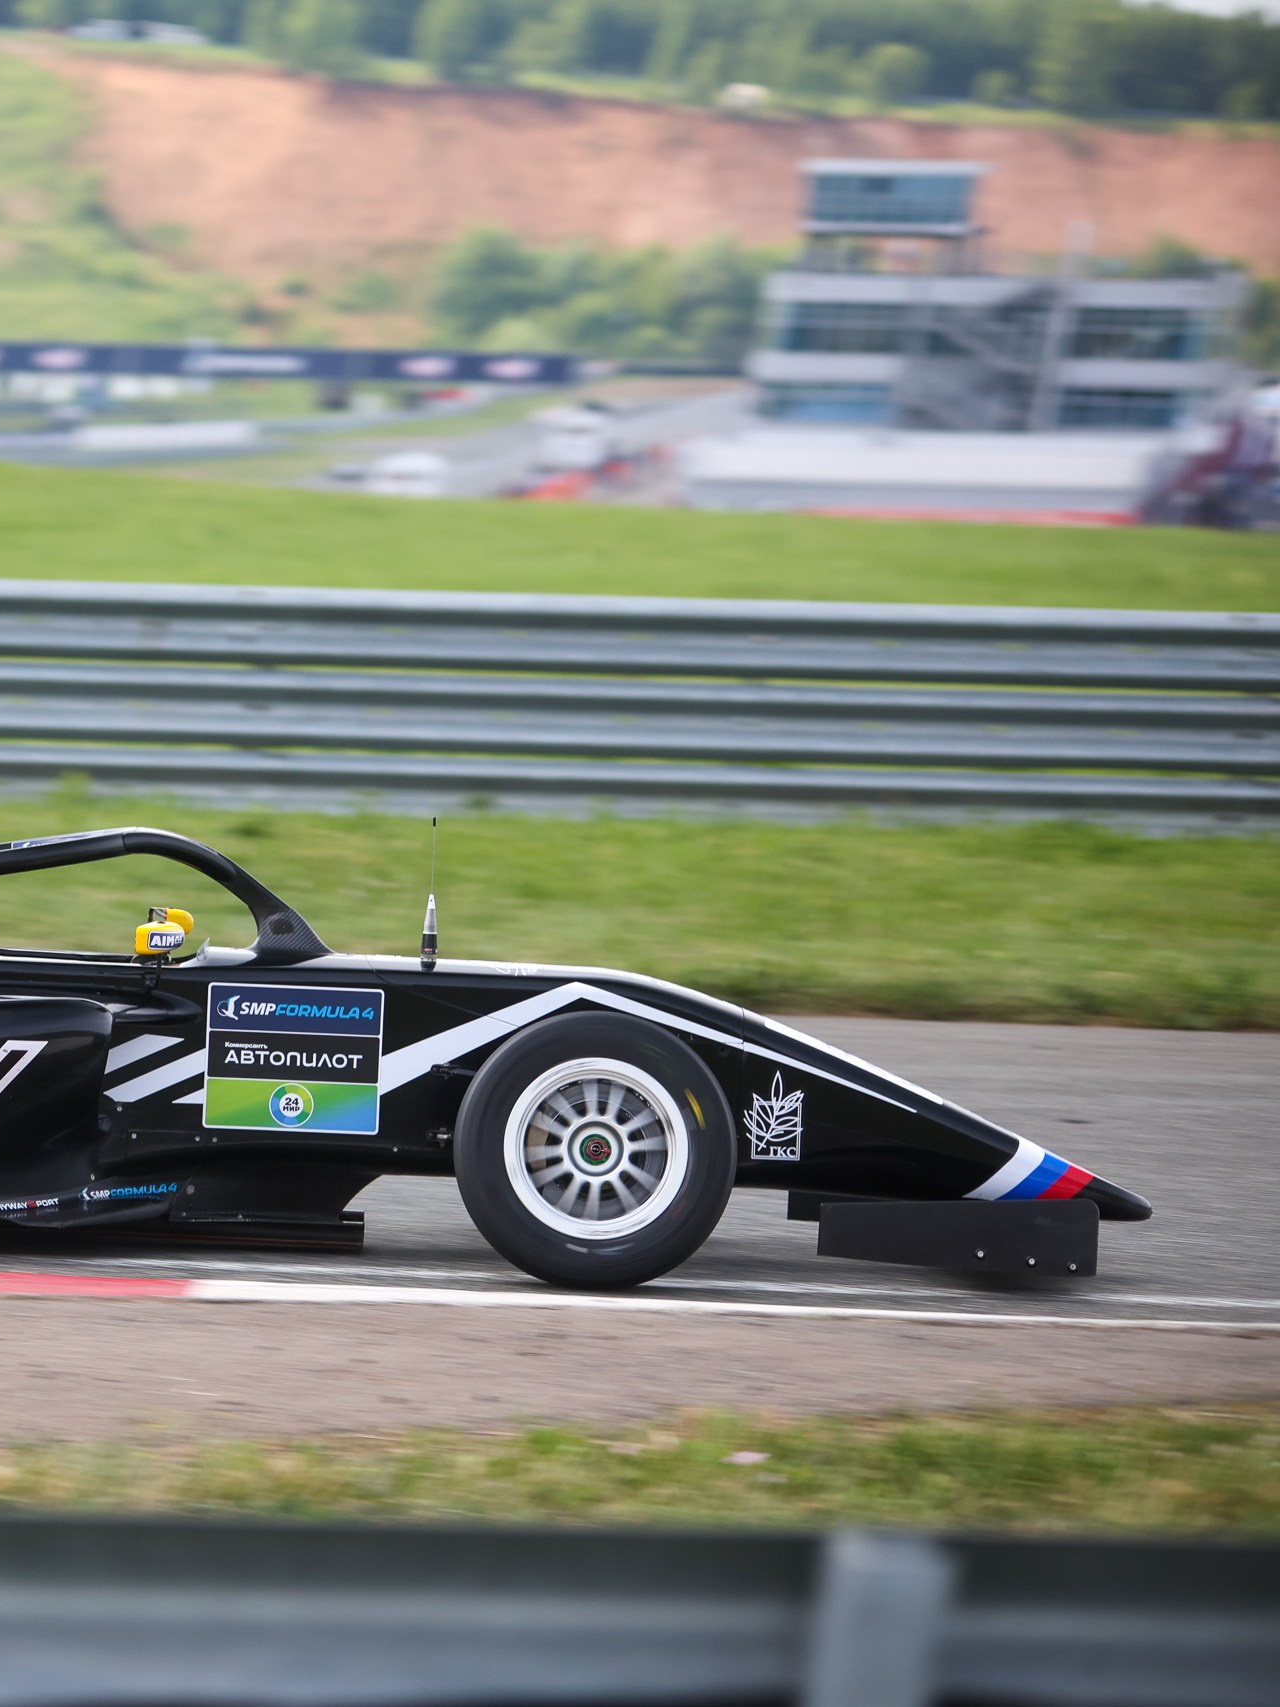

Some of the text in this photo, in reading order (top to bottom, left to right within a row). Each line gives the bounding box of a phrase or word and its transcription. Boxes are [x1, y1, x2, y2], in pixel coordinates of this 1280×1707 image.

[224, 1049, 363, 1069] АВТОПИЛОТ
[284, 1097, 299, 1106] 24
[769, 1146, 797, 1158] ГКС
